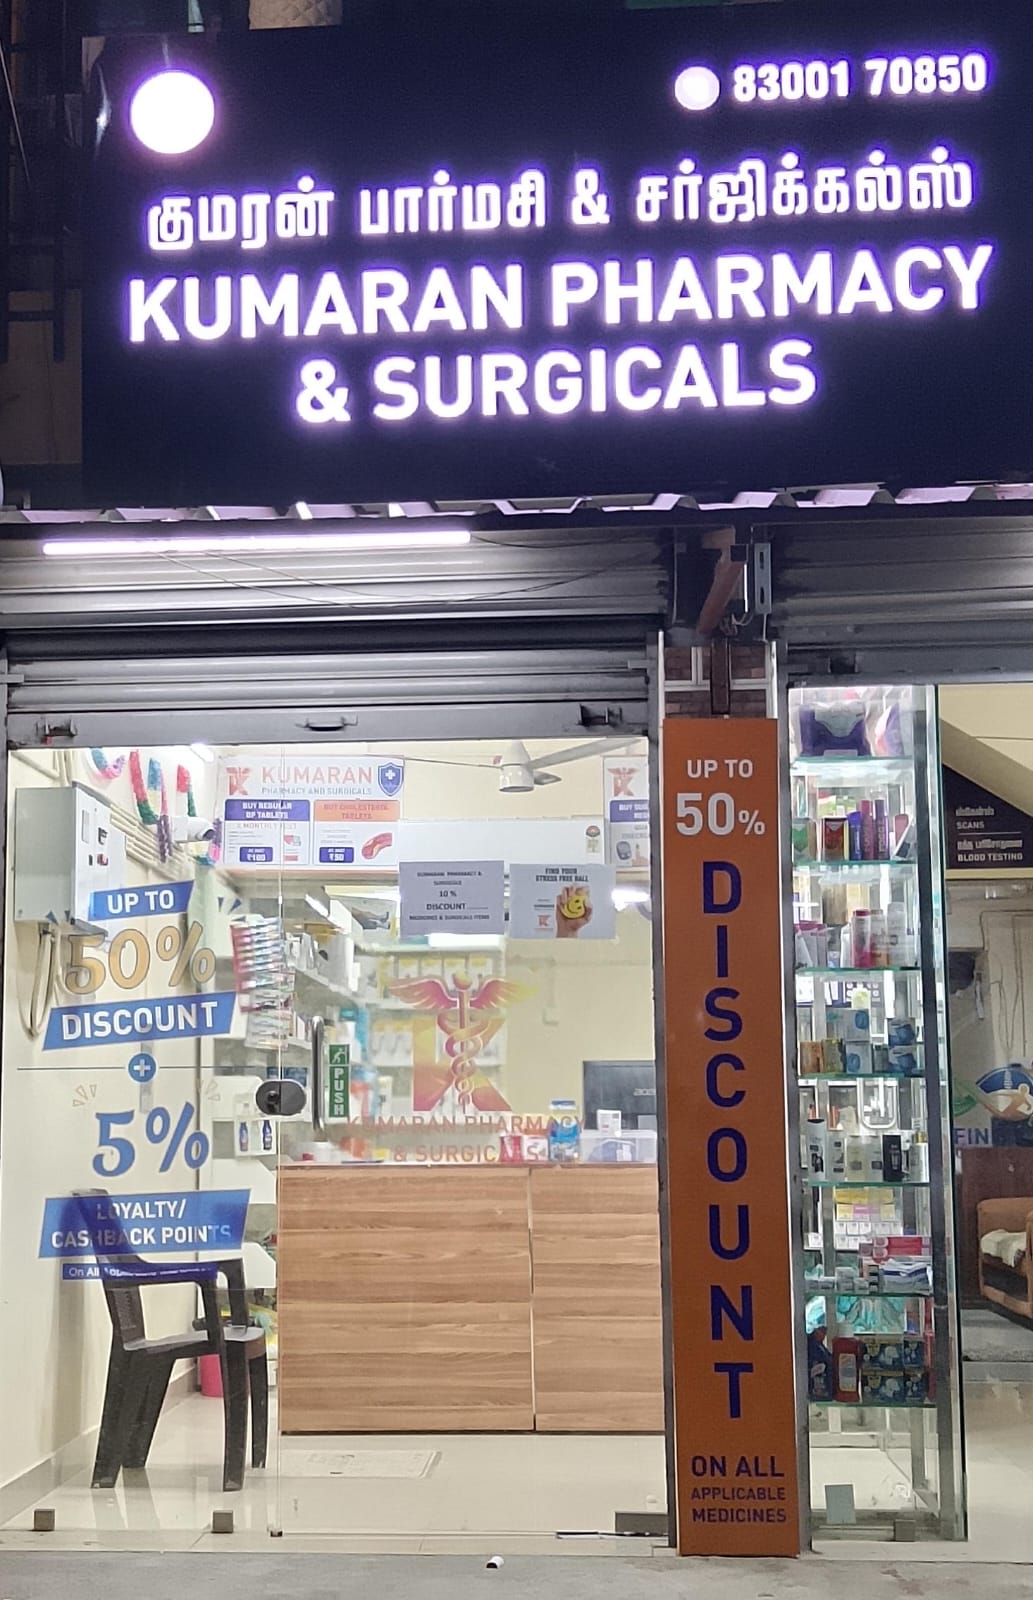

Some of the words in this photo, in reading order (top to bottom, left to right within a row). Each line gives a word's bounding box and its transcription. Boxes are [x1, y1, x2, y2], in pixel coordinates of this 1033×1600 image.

[732, 60, 850, 104] 83001
[864, 52, 989, 97] 70850
[148, 176, 335, 251] குமரன்
[359, 168, 547, 236] பார்மசி
[571, 168, 611, 226] &
[635, 145, 973, 224] சர்ஜிக்கல்ஸ்
[128, 264, 525, 343] KUMARAN
[550, 245, 994, 329] PHARMACY
[295, 358, 352, 425] &
[372, 338, 818, 421] SURGICALS
[262, 766, 373, 785] KUMARAN
[686, 759, 718, 778] UP
[724, 759, 754, 778] TO
[675, 791, 766, 837] 50%
[107, 893, 139, 915] UP
[144, 889, 175, 912] TO
[426, 903, 467, 911] DISCOUNT
[64, 920, 217, 995] 50%
[62, 1001, 218, 1041] DISCOUNT
[333, 1067, 345, 1117] PUSH
[464, 1115, 586, 1134] PHARMACY
[92, 1101, 210, 1177] 5%
[702, 860, 754, 1419] DISCOUNT
[393, 1146, 407, 1163] &
[415, 1145, 541, 1163] SURGICALS
[162, 1224, 232, 1245] POINTS
[68, 1266, 85, 1277] On
[691, 1455, 728, 1478] ON
[735, 1455, 785, 1477] ALL
[690, 1486, 786, 1501] APPLICABLE
[692, 1507, 787, 1523] MEDICINES
